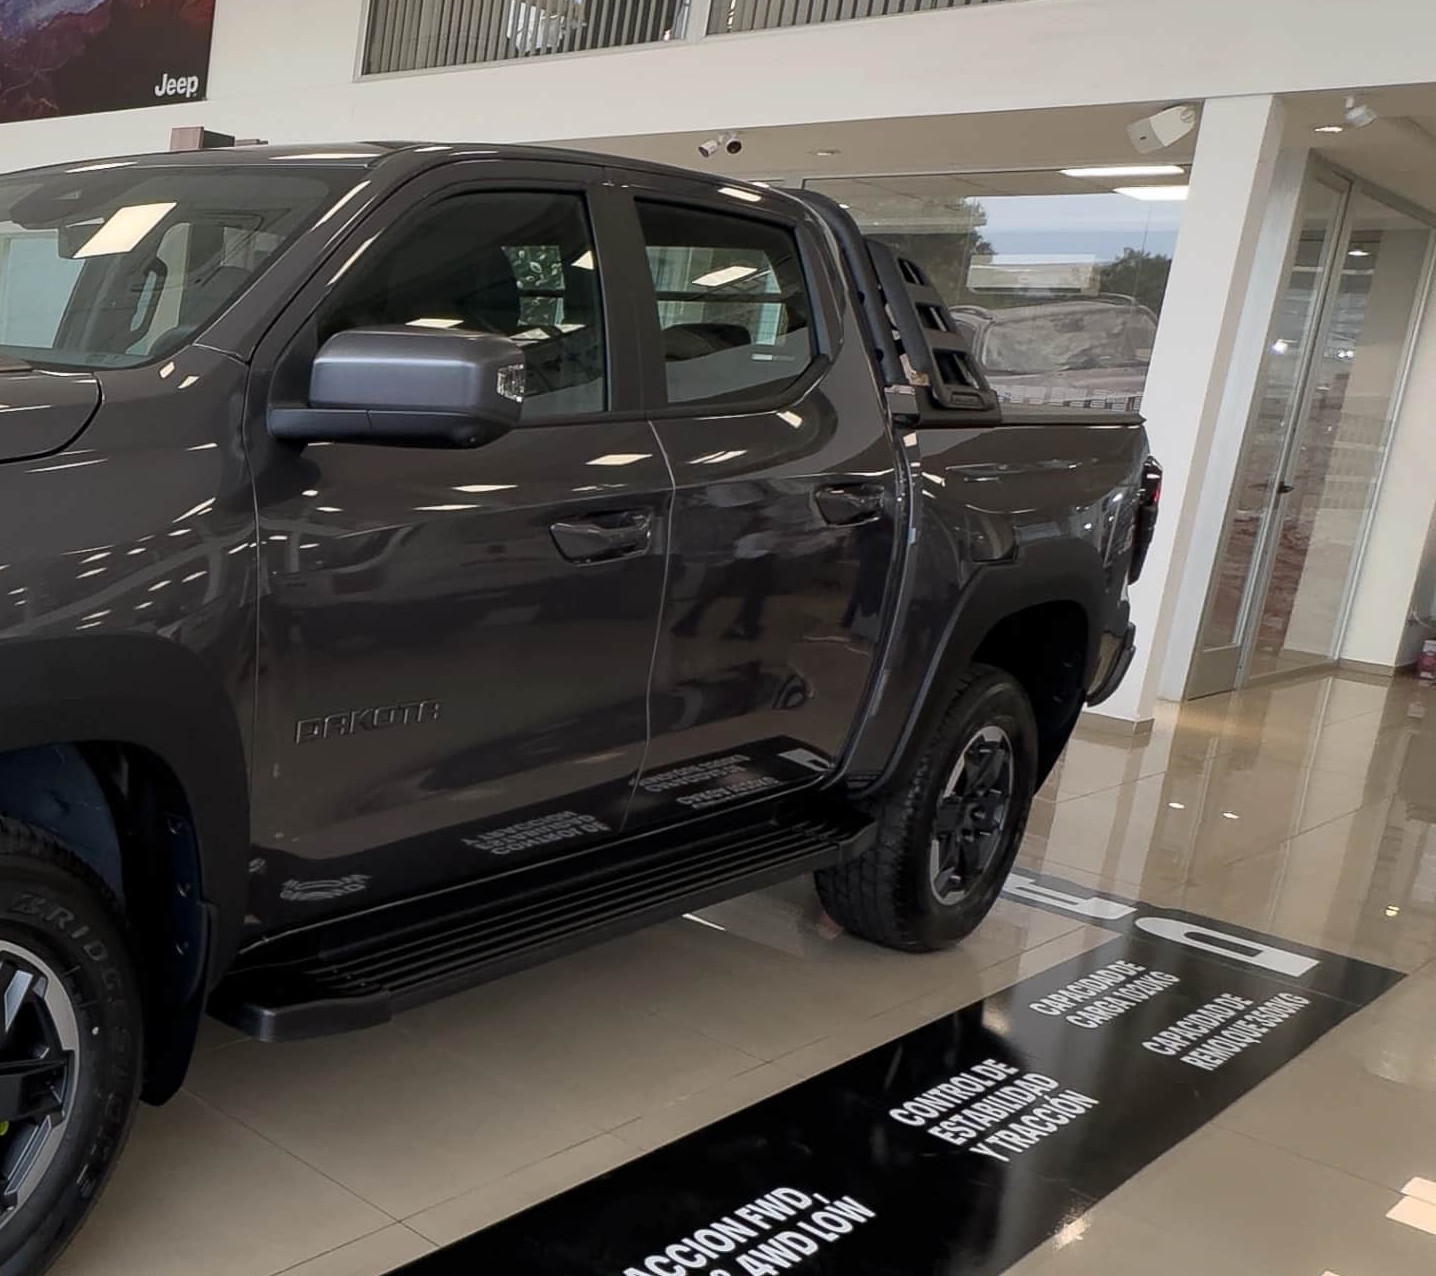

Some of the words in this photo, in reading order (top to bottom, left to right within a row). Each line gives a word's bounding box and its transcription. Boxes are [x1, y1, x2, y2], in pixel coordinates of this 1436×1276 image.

[155, 73, 199, 98] Jeep
[293, 699, 441, 745] DAKOTA
[1029, 969, 1127, 1016] CAPACIDAD
[1107, 959, 1147, 976] DE
[1066, 996, 1131, 1028] CARGA
[1142, 1004, 1237, 1055] CAPACIDAD
[1213, 993, 1254, 1011] DE
[1180, 1020, 1269, 1071] REMOLQUE
[889, 1072, 996, 1127] CONTROL
[970, 1058, 1019, 1081] DE
[927, 1073, 1059, 1146] ESTABILIDAD
[985, 1089, 1099, 1153] TRACCIÓN
[969, 1143, 1010, 1162] Y
[796, 1195, 876, 1242] LOW
